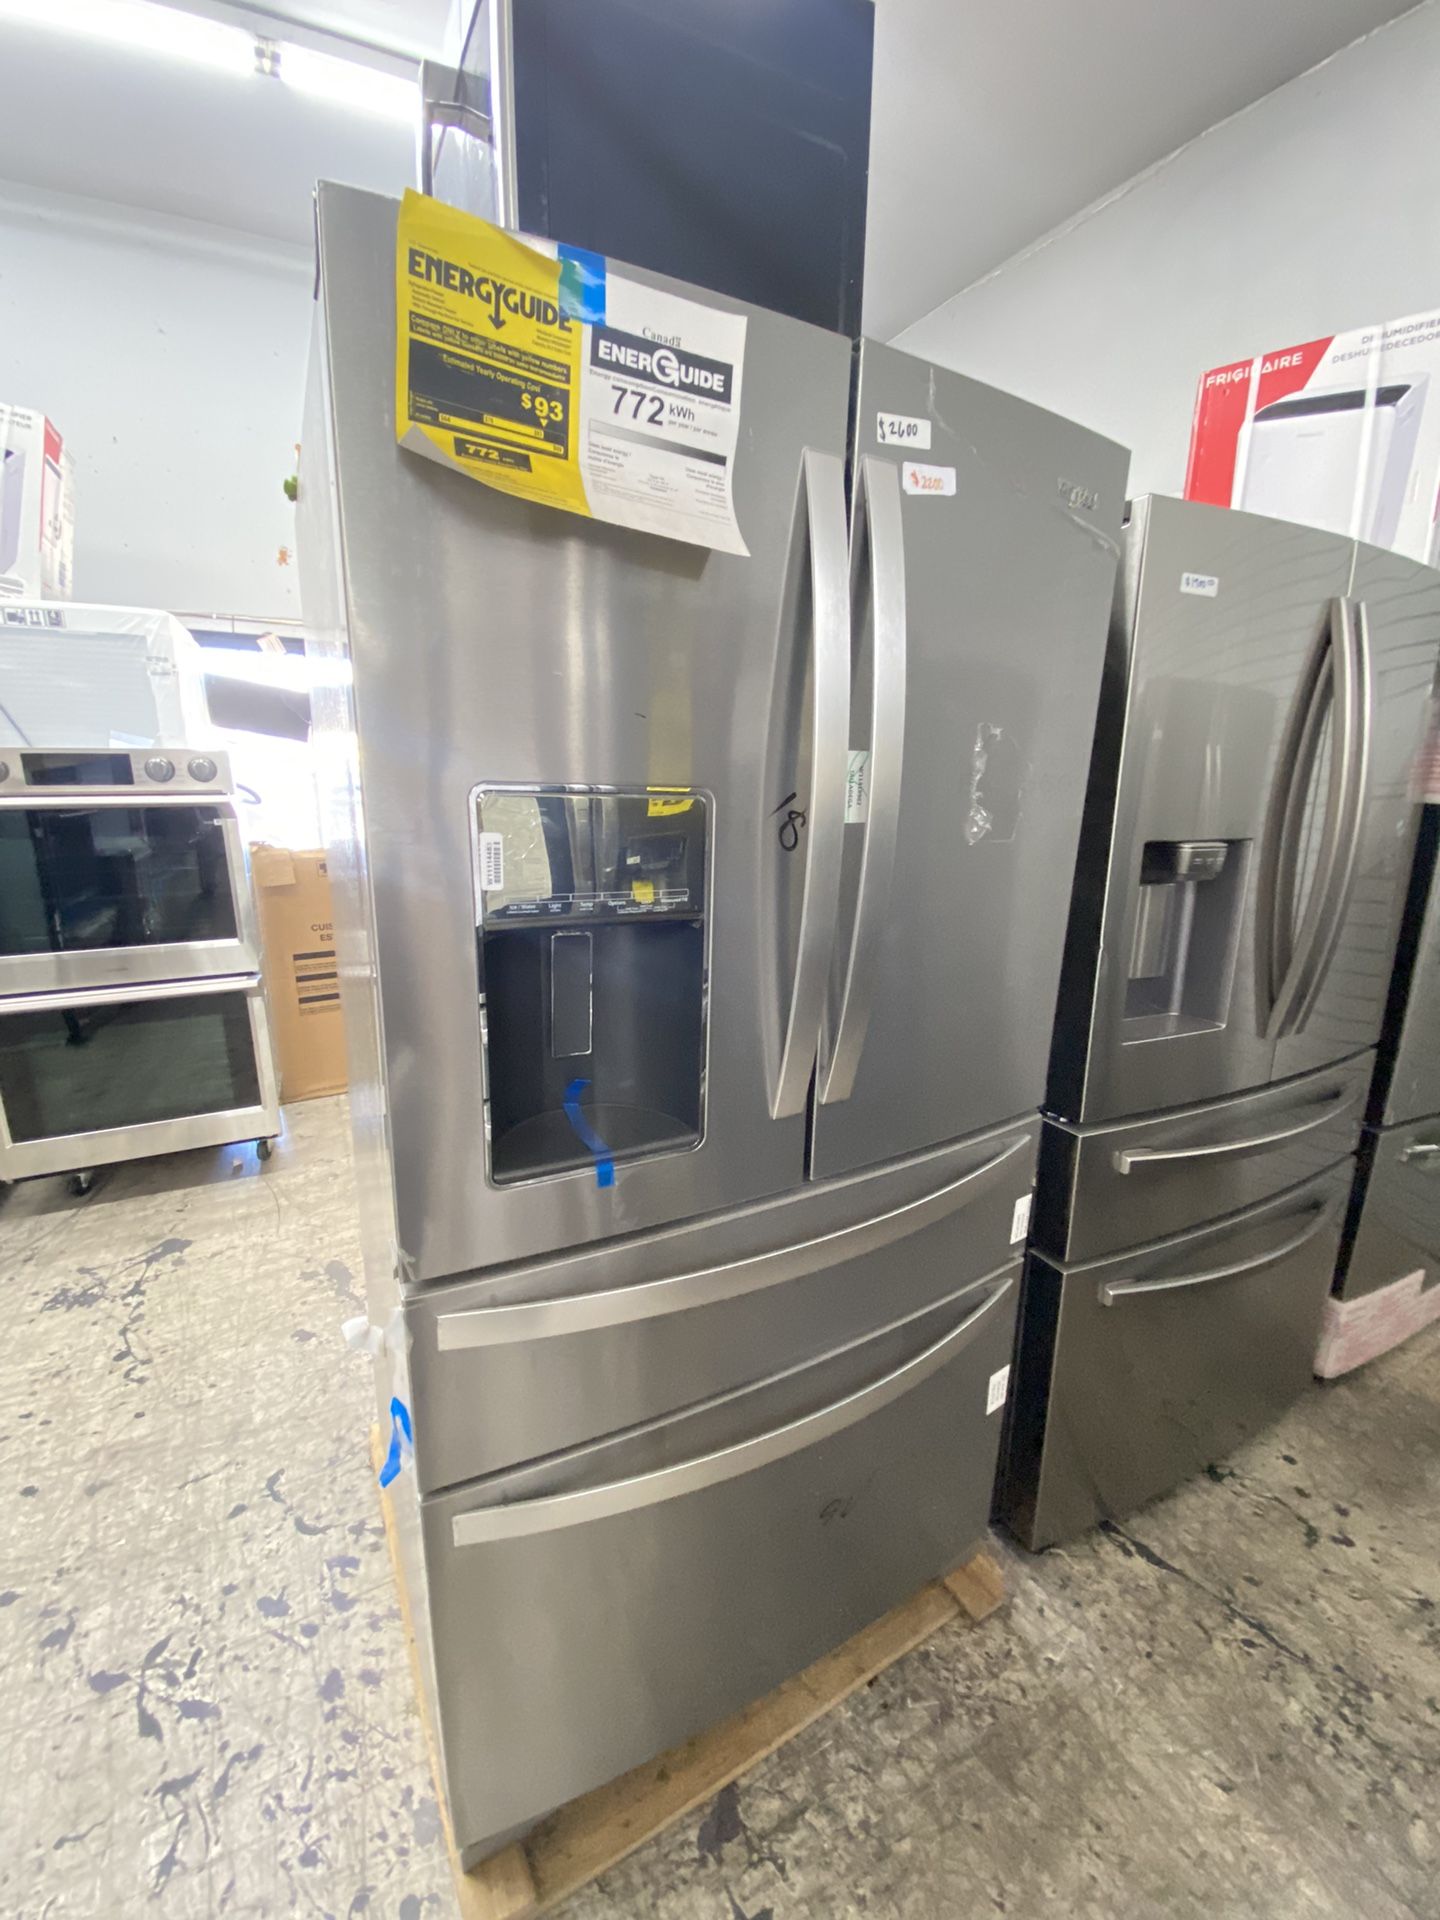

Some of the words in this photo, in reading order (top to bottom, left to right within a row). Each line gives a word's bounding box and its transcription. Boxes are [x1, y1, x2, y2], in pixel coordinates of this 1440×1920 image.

[408, 247, 573, 333] ENERGYGUIDE
[598, 338, 724, 393] ENERGUIDE
[1206, 351, 1304, 389] FRIGIAIRE
[520, 392, 564, 422] $93
[611, 384, 665, 426] 772
[669, 403, 695, 422] kWh
[878, 416, 918, 441] $2600
[465, 443, 500, 460] 772
[319, 933, 334, 942] ES
